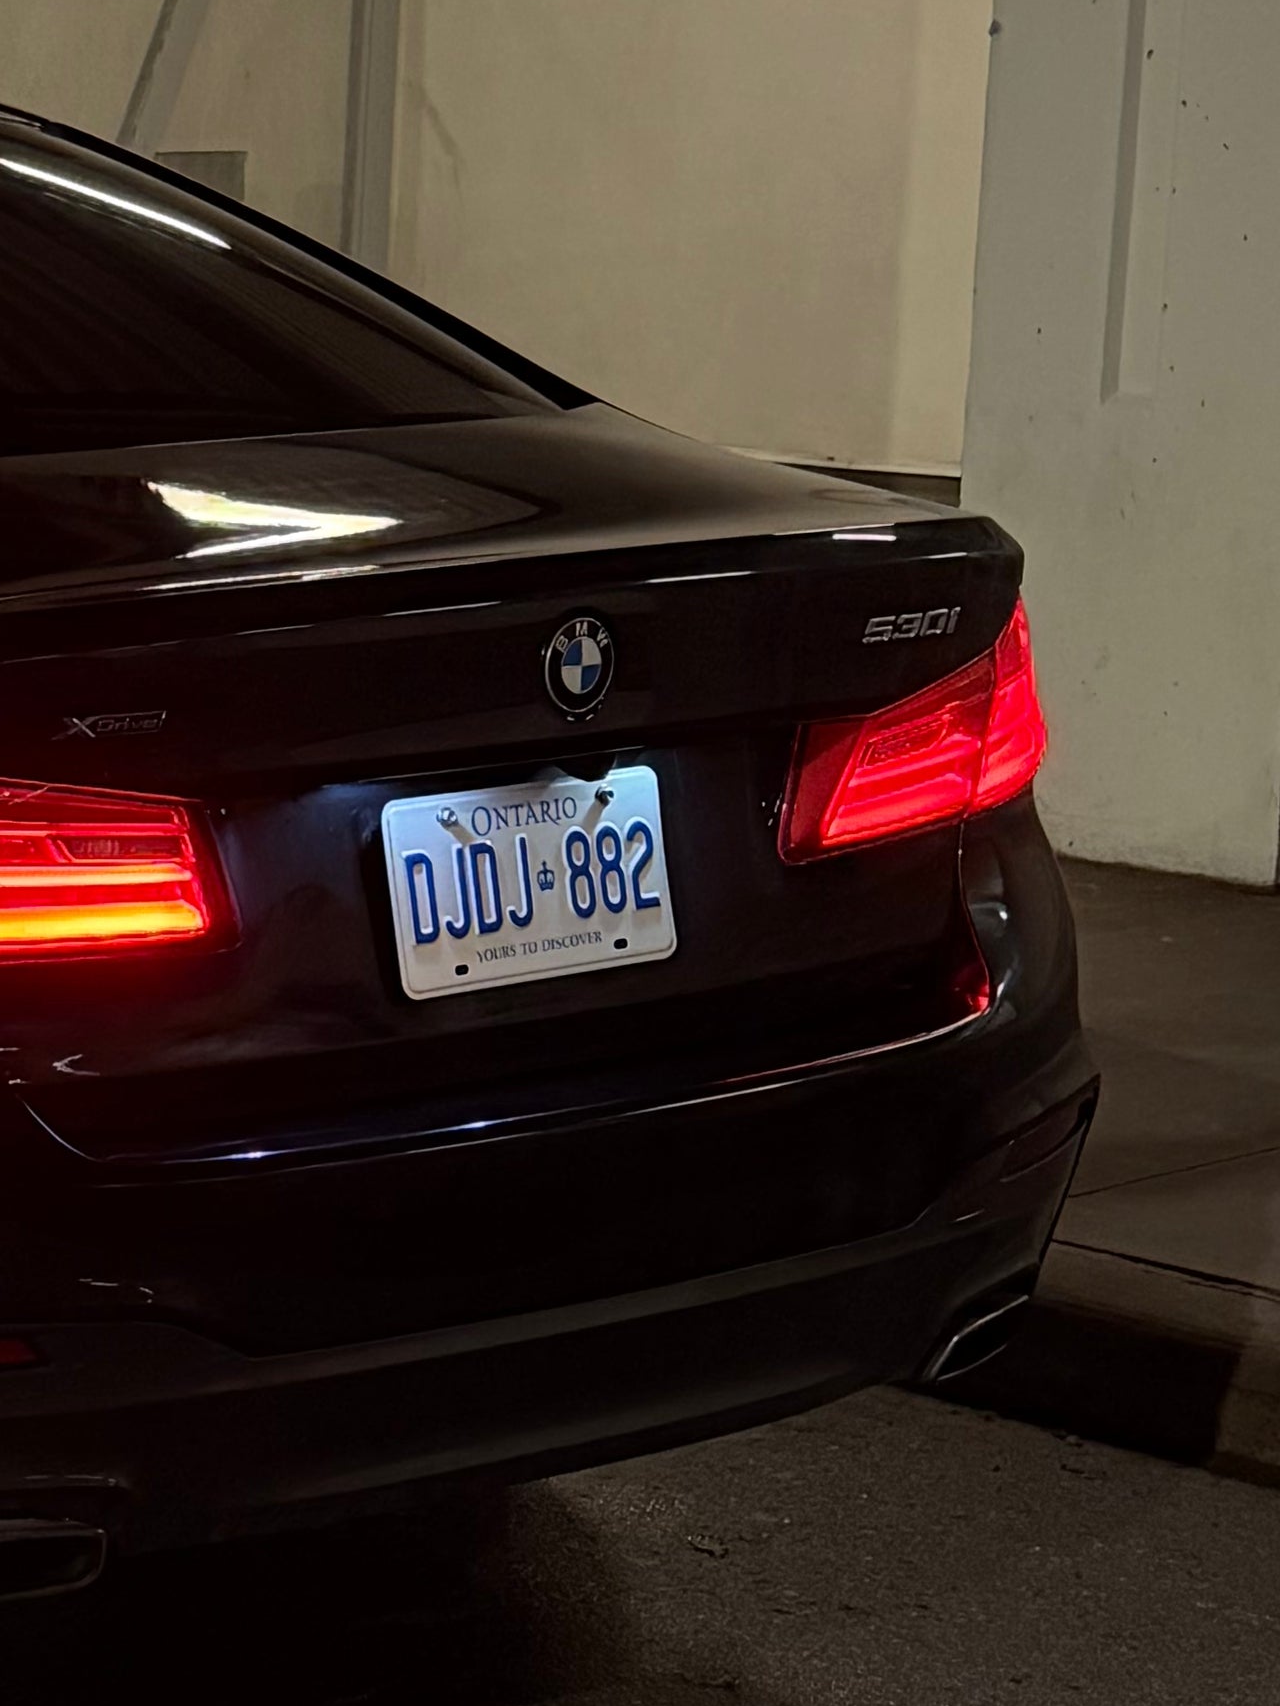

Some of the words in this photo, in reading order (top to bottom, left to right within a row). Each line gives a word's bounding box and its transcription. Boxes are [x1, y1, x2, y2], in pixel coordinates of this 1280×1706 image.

[556, 621, 609, 653] BMW
[471, 796, 577, 836] ONTARIO
[403, 833, 534, 945] DJDJ
[562, 816, 661, 919] 882
[476, 944, 516, 963] YOURS
[521, 941, 538, 955] TO
[542, 931, 602, 952] DISCOVER
